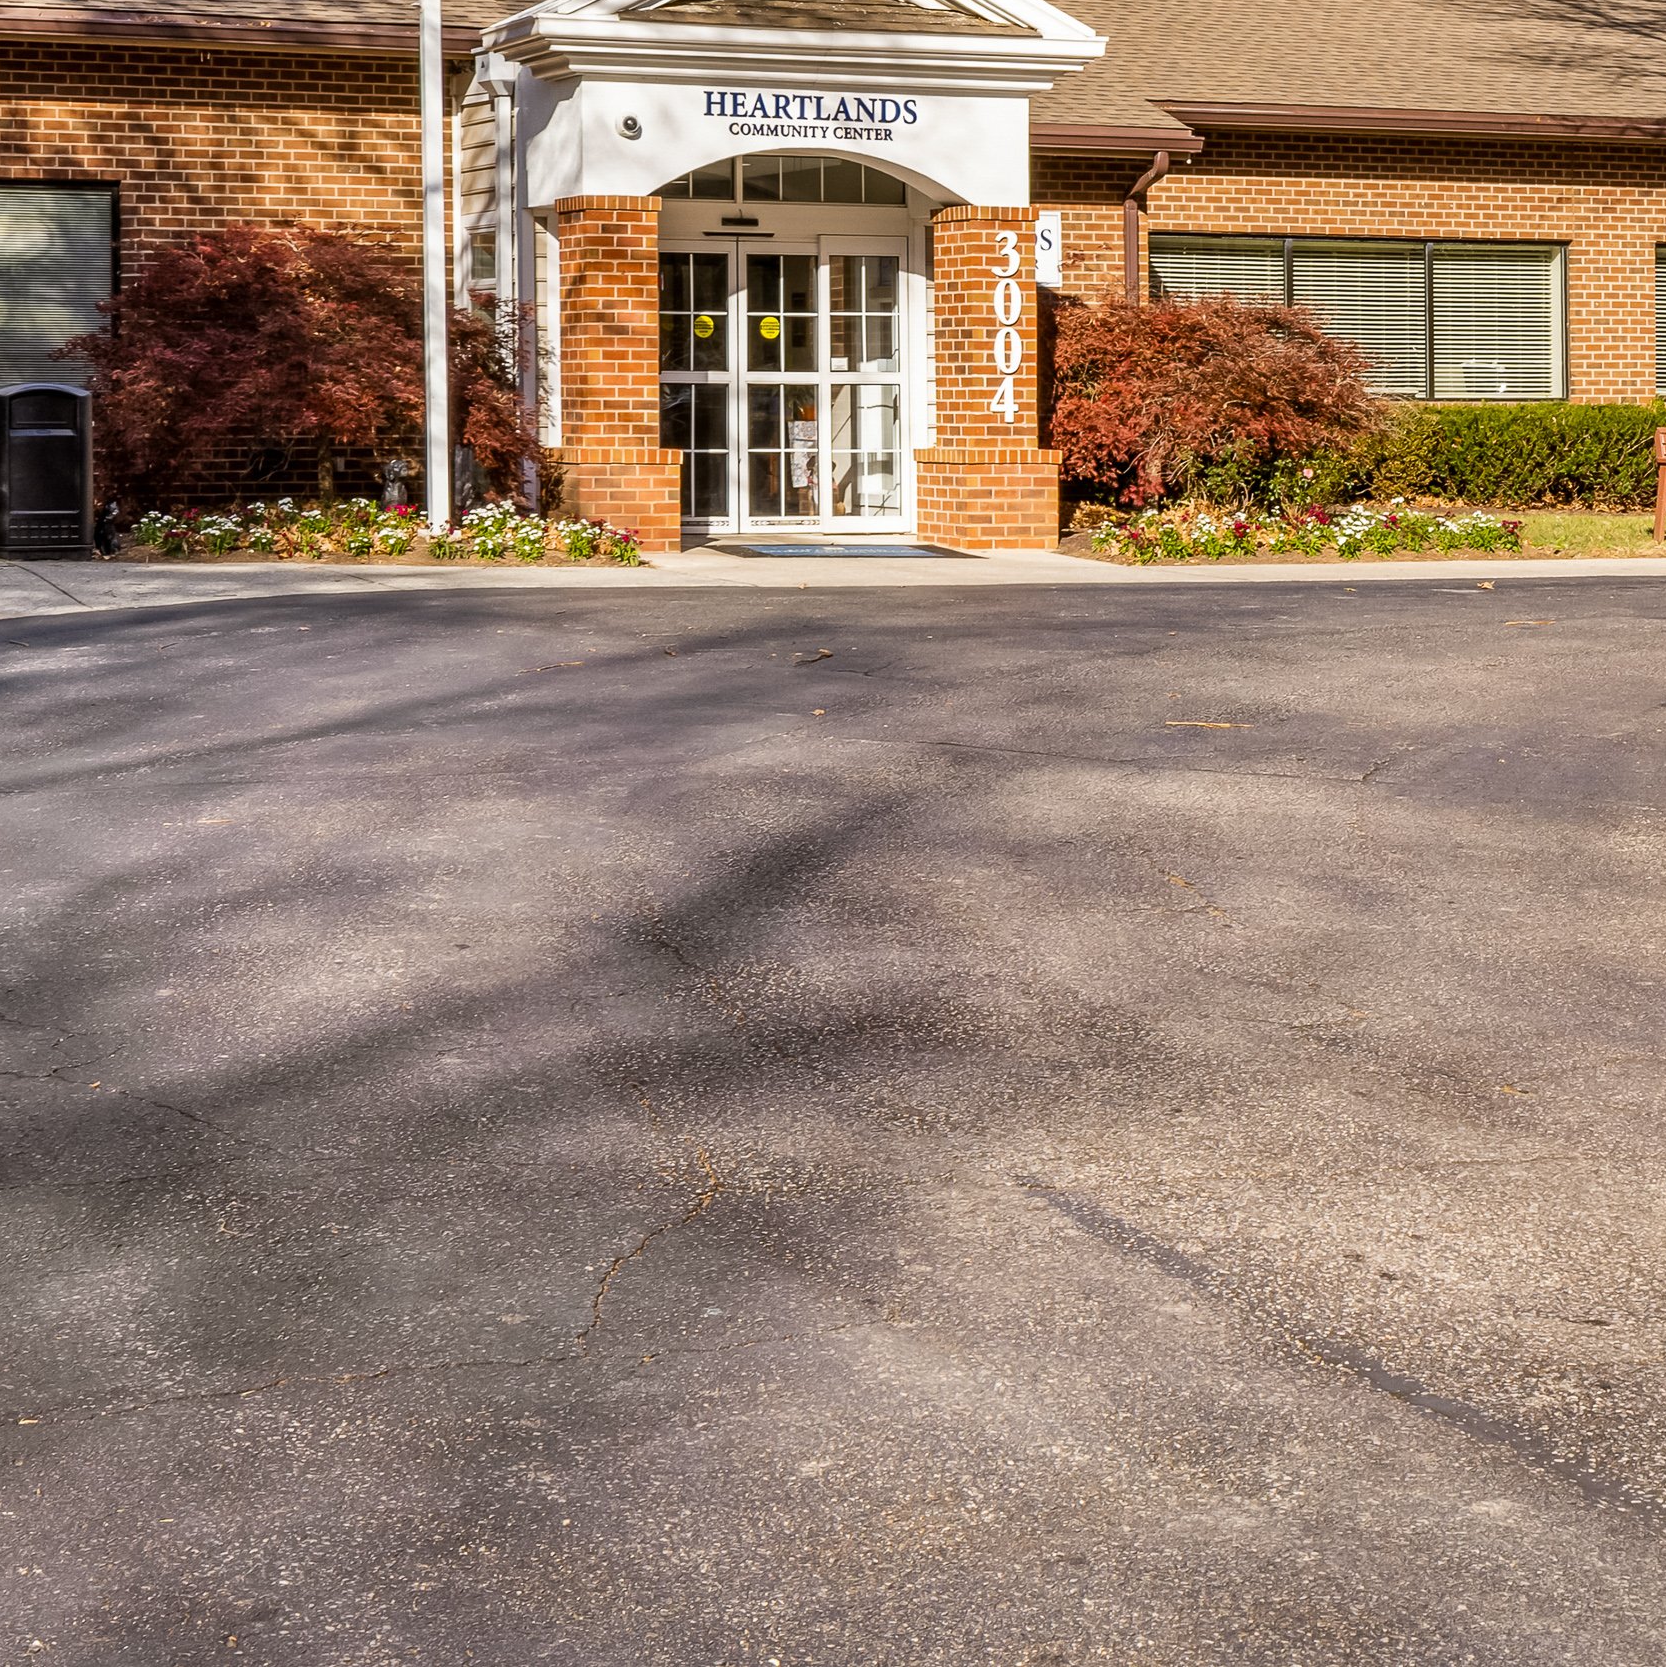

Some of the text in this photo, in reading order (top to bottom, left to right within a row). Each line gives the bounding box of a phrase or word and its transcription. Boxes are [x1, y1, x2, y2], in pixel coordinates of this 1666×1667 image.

[703, 90, 918, 124] HEARTLANDS
[729, 122, 893, 141] COMMUNITY CENTER
[989, 230, 1023, 424] 3004
